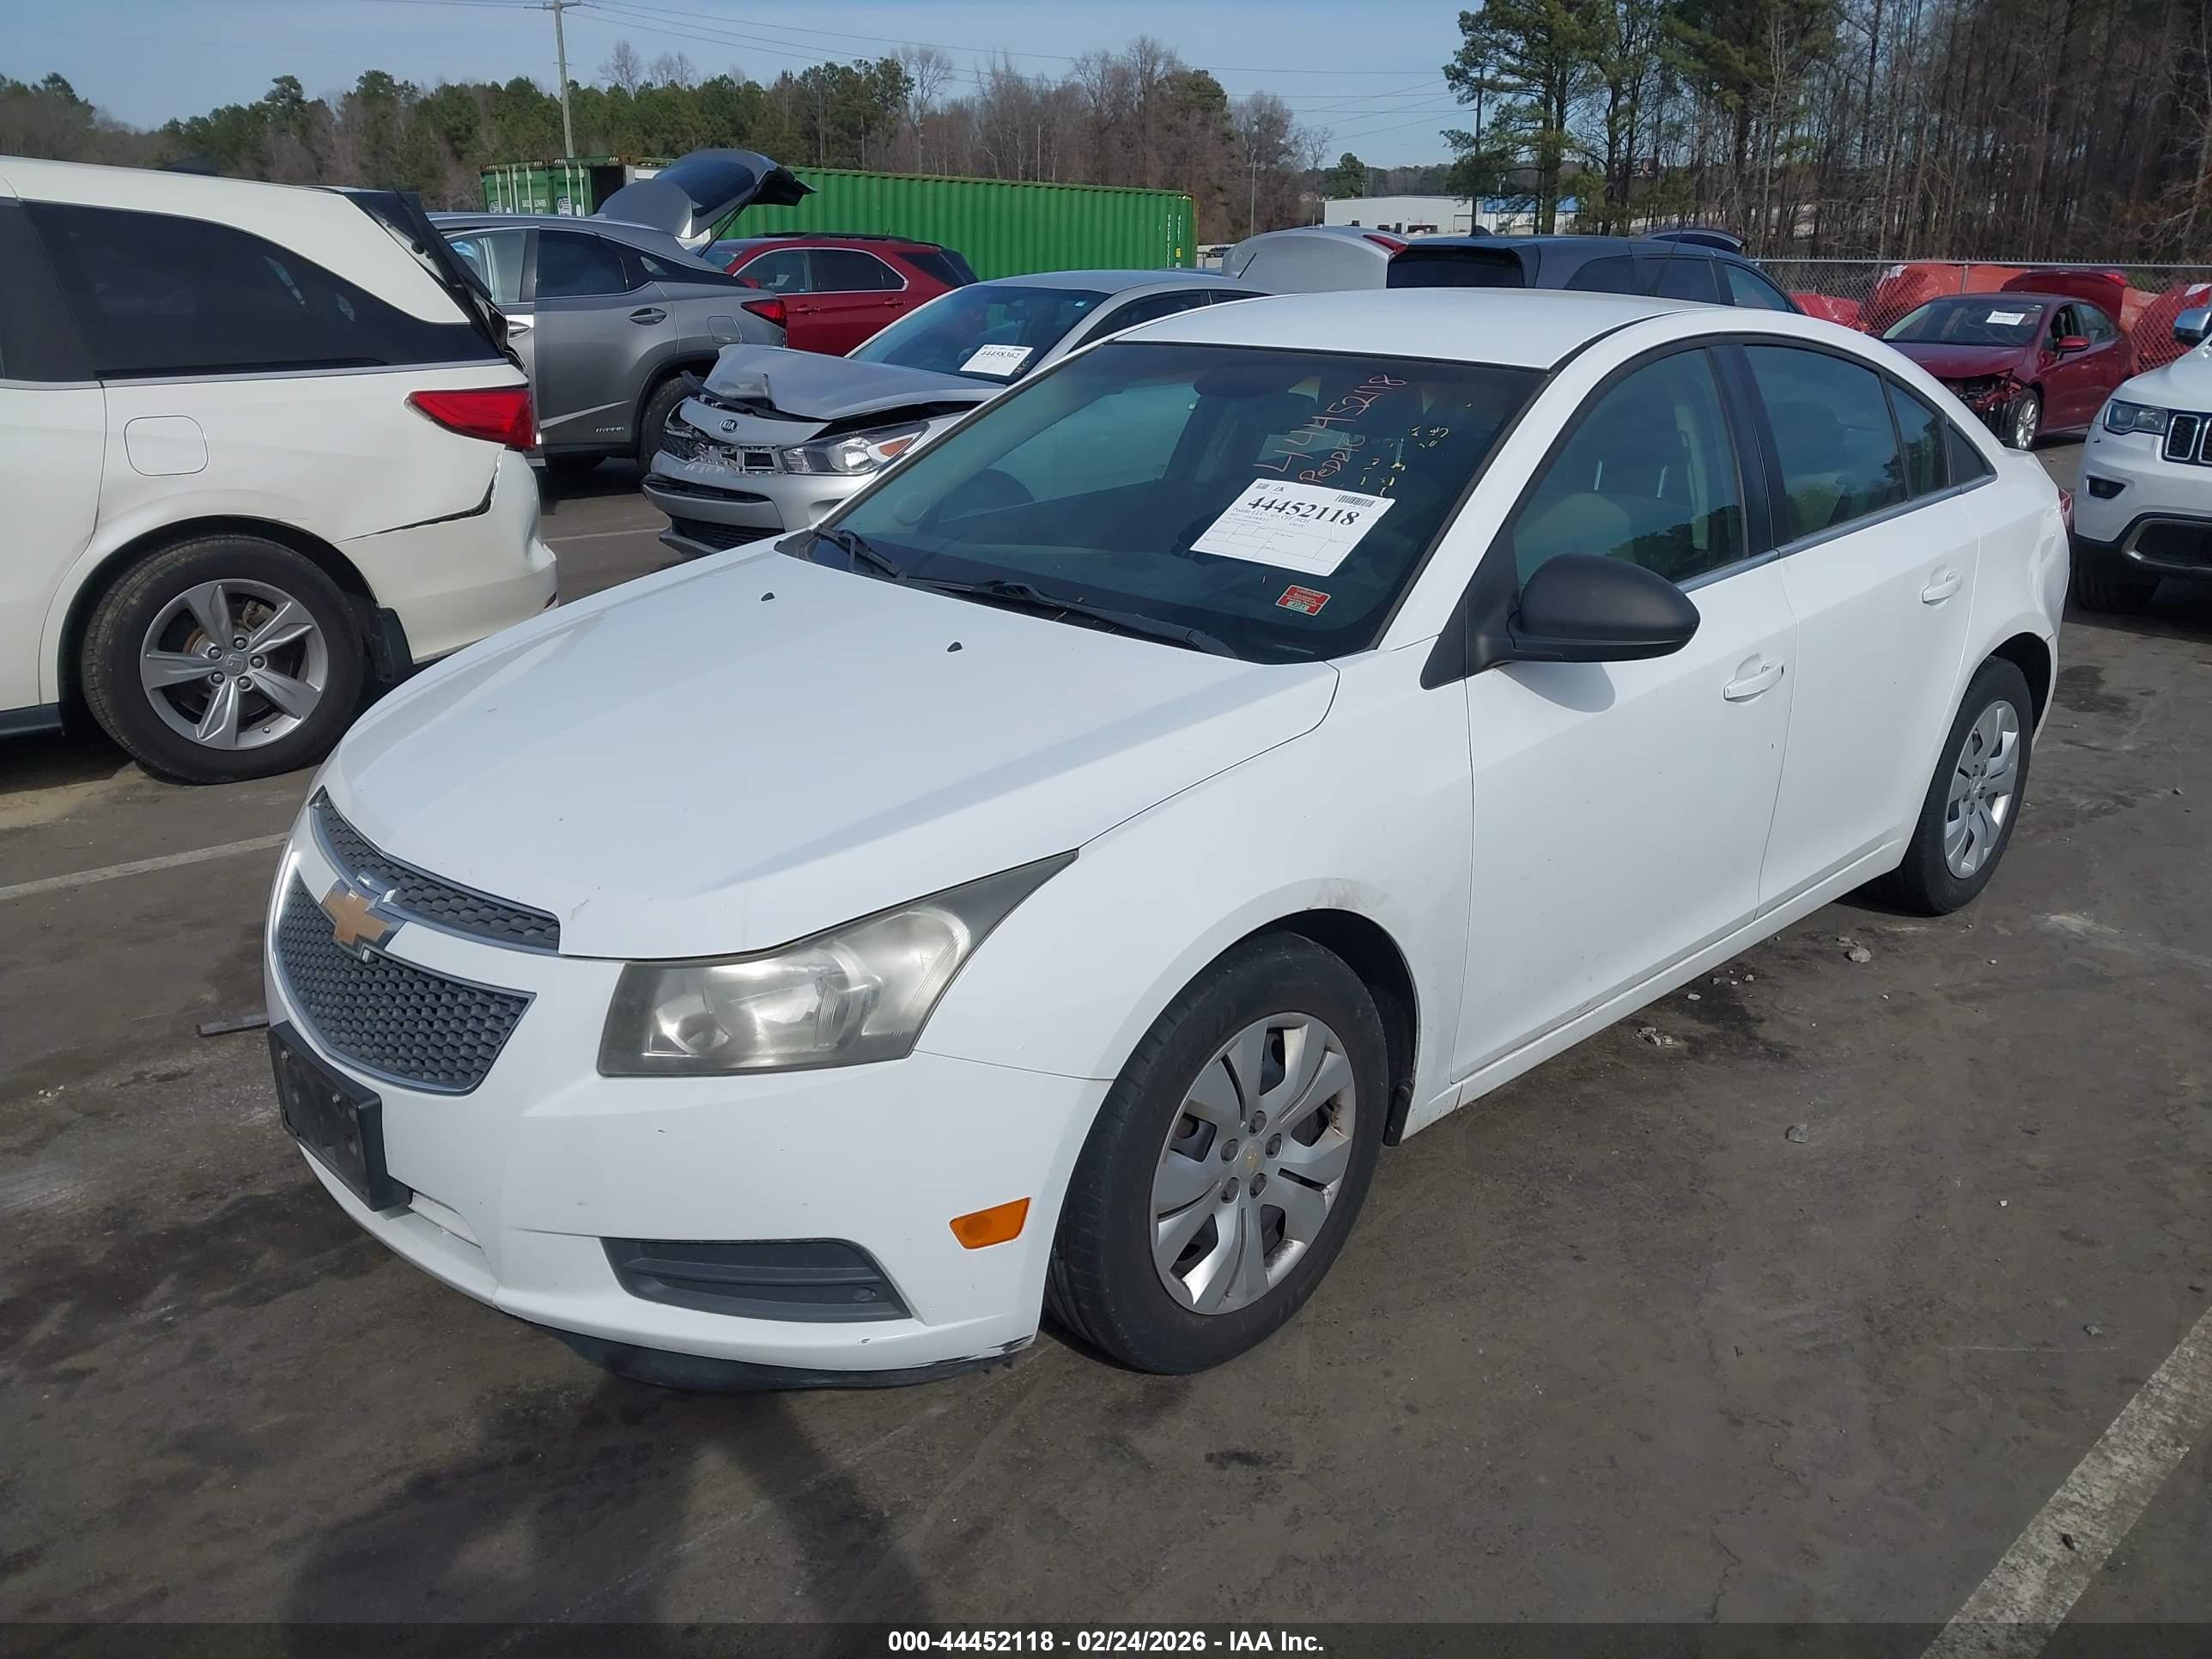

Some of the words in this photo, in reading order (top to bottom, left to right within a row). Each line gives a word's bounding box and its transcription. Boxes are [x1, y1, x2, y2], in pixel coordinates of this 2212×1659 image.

[721, 419, 737, 431] KIA
[1252, 374, 1408, 472] 44452118
[1248, 495, 1360, 526] 44452118
